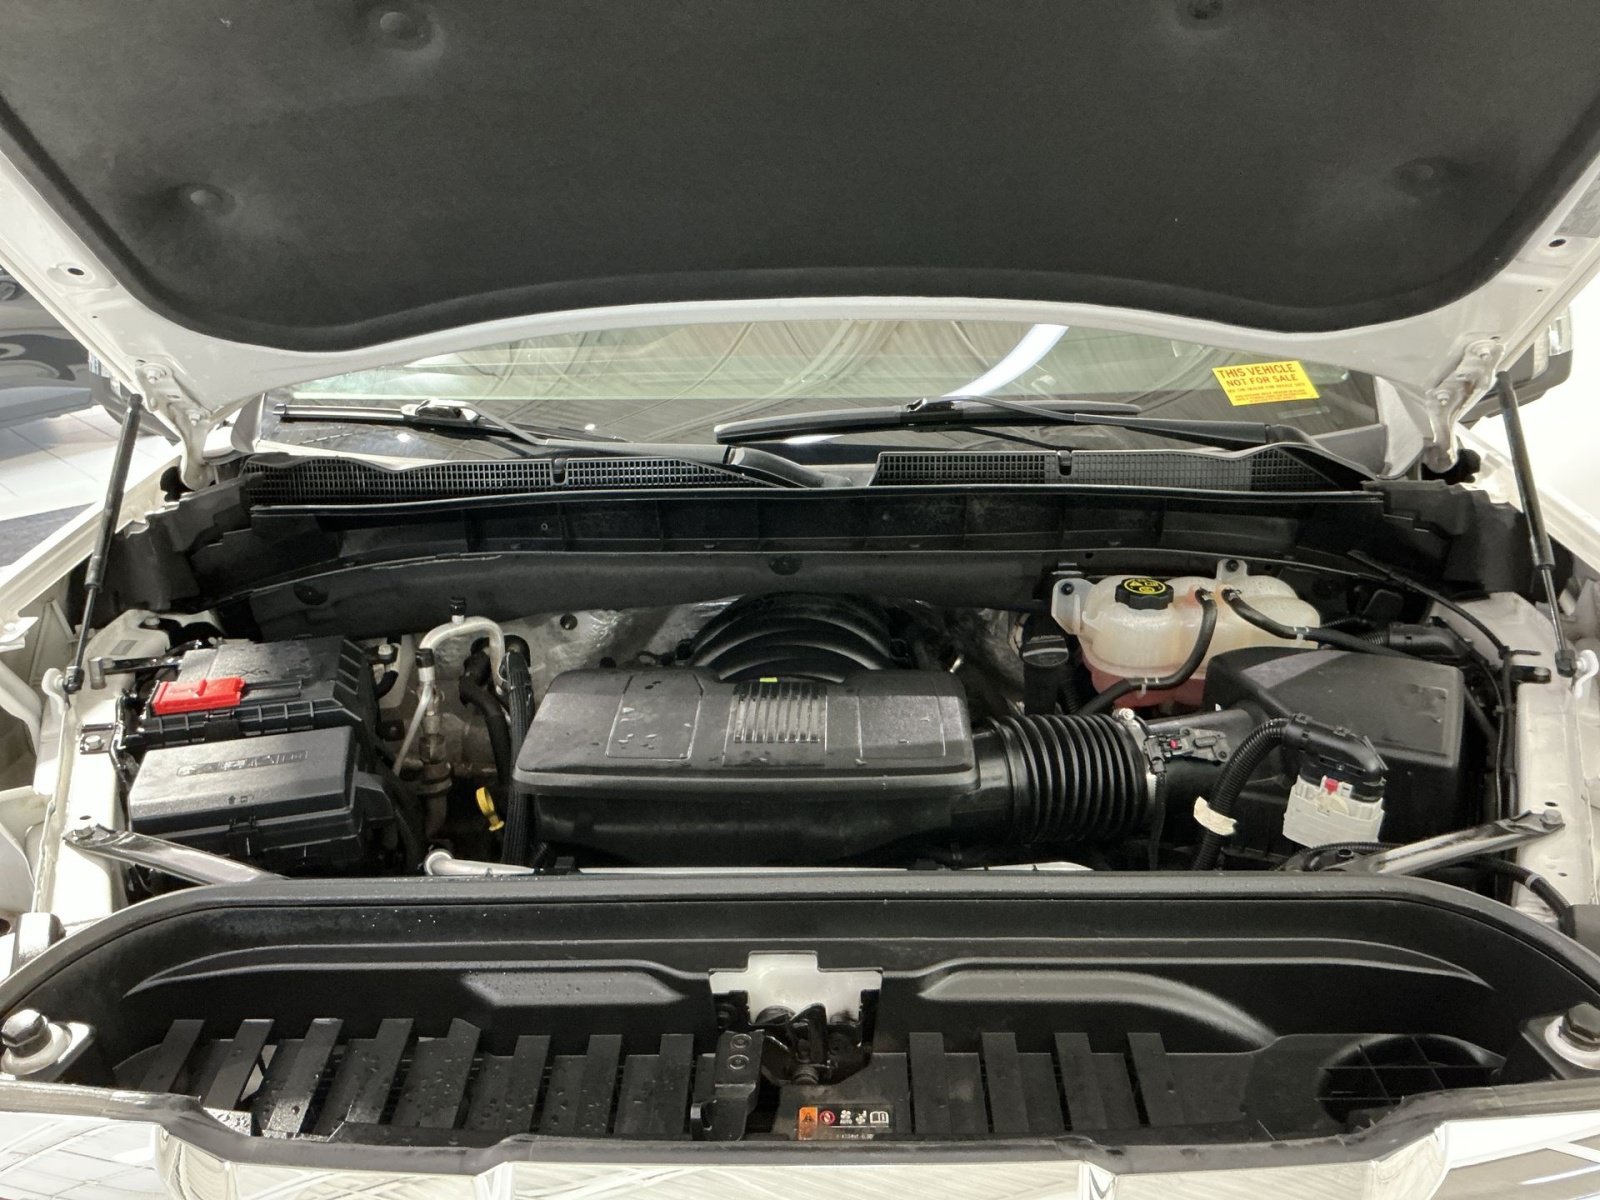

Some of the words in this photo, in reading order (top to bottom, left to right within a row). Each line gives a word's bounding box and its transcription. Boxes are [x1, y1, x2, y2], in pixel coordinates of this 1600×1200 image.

[1217, 368, 1246, 379] THIS
[1246, 363, 1296, 376] VEHICLE
[1226, 379, 1247, 387] NOT
[1249, 376, 1270, 384] FOR
[1273, 374, 1299, 383] SALE
